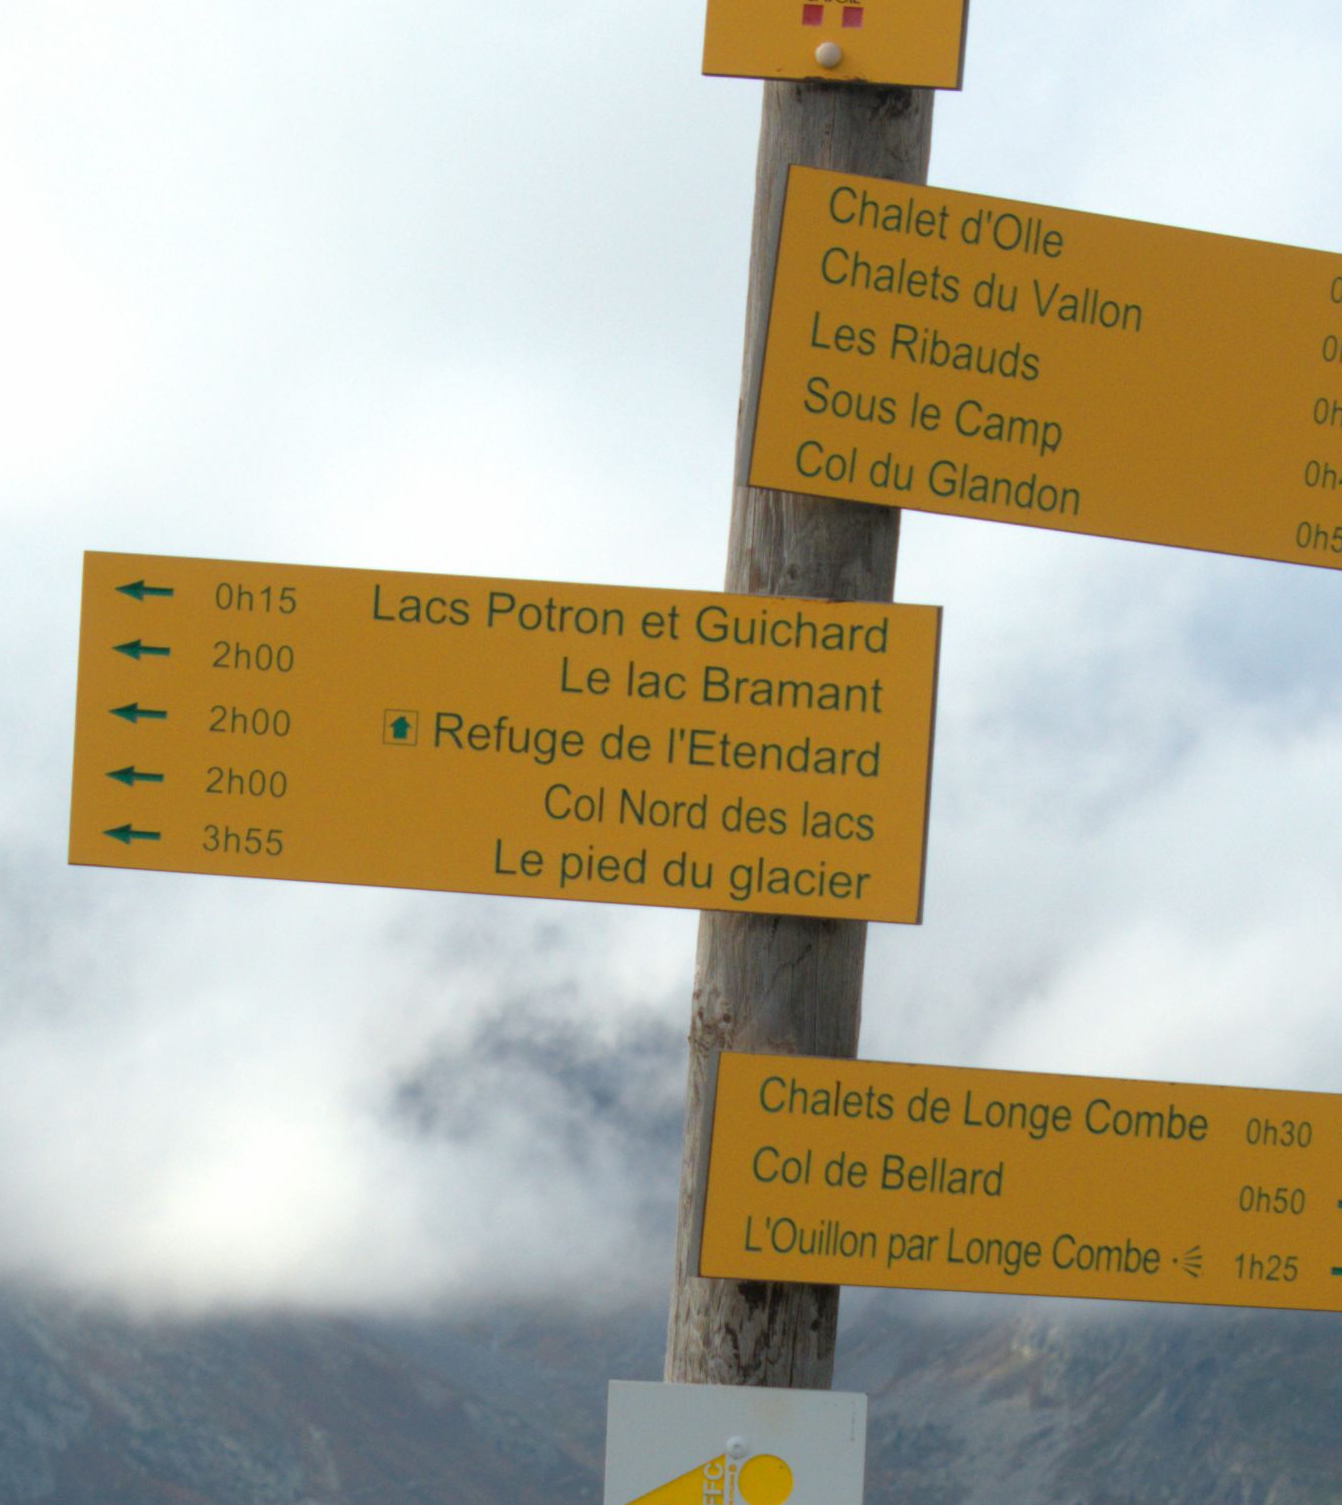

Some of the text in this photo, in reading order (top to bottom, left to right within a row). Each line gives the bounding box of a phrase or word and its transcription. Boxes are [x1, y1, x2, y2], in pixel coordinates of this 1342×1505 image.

[829, 187, 1064, 258] Chalet d'Olle
[821, 247, 1143, 332] Chalets du Vallon
[811, 311, 1039, 381] Les Ribauds
[804, 377, 1063, 456] Sous le Camp
[796, 441, 1080, 516] Col du Glandon
[216, 582, 297, 614] 0h15
[373, 584, 888, 653] Lacs Potron et Guichard
[213, 641, 295, 672] 2h00
[561, 657, 883, 713] Le lac Bramant
[209, 705, 291, 737] 2h00
[434, 712, 881, 777] Refuge de l'Etendard
[206, 767, 287, 798] 2h00
[202, 825, 284, 856] 3h55
[545, 784, 874, 841] Col Nord des lacs
[495, 839, 870, 900] Le pied du glacier
[759, 1076, 1209, 1141] Chalets de Longe Combe
[1246, 1118, 1312, 1148] 0h30
[752, 1146, 1004, 1197] Col de Bellard
[1239, 1186, 1305, 1216] 0h50
[745, 1216, 1161, 1276] L'Ouillon par Longe Combe
[1234, 1252, 1299, 1282] 1h25
